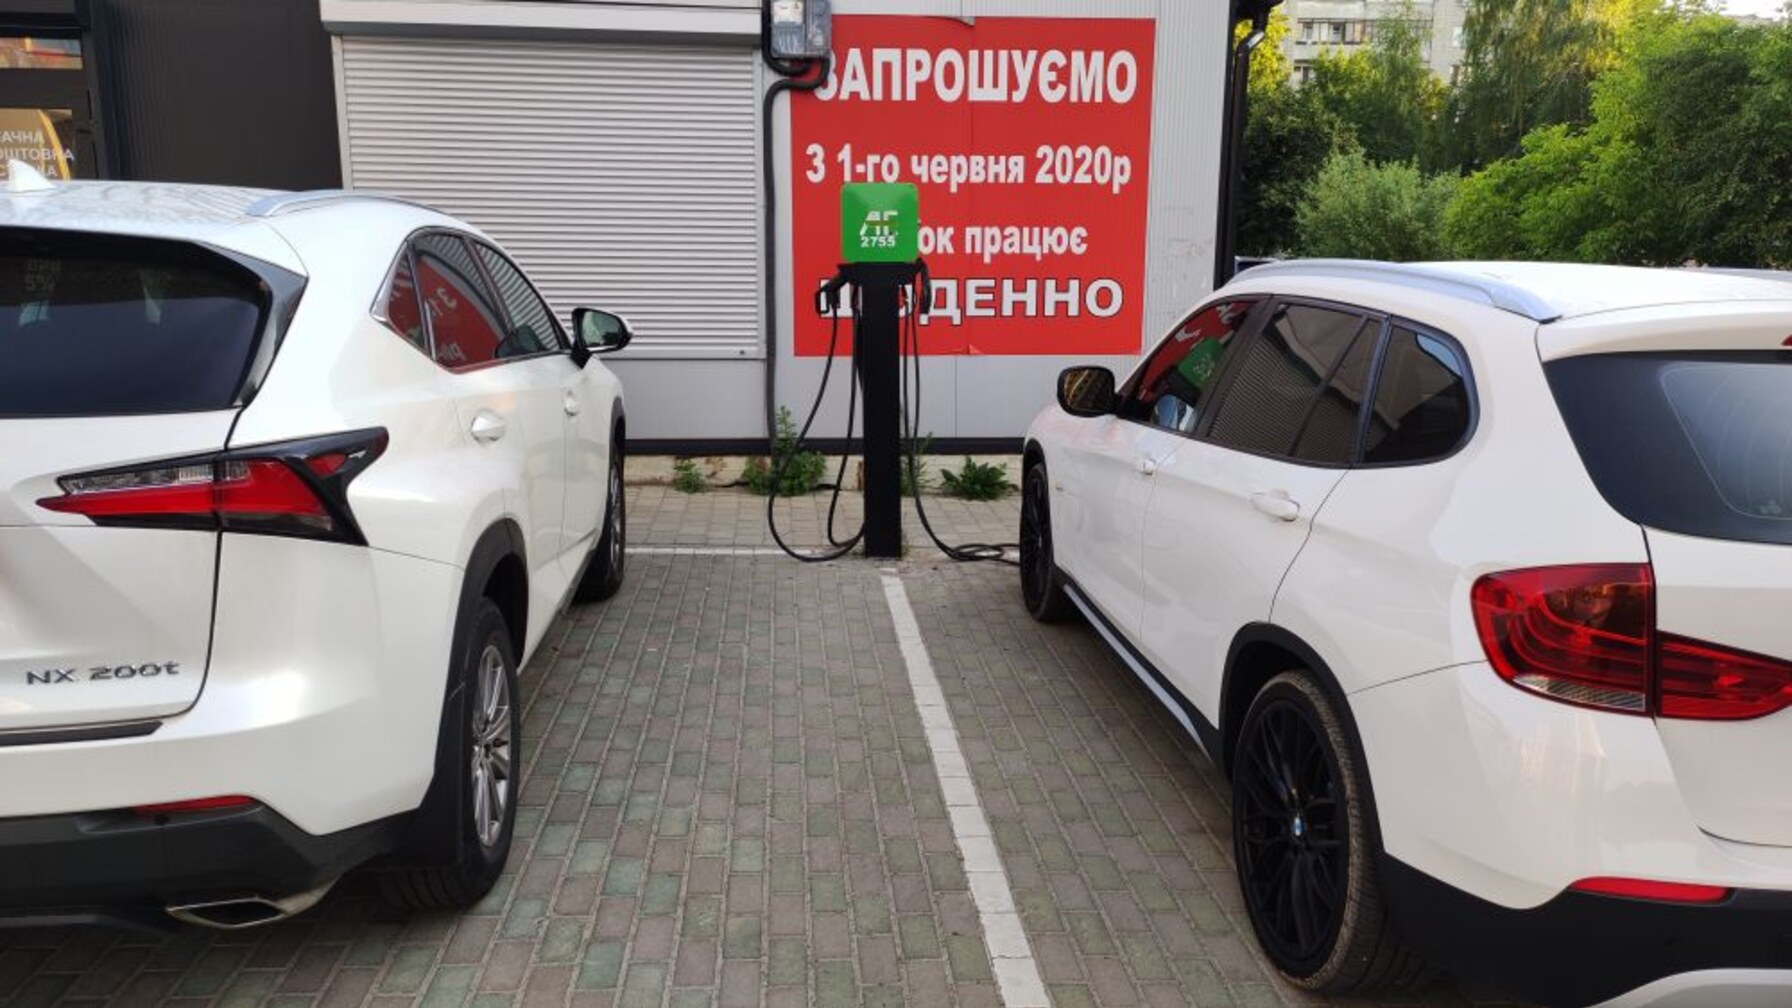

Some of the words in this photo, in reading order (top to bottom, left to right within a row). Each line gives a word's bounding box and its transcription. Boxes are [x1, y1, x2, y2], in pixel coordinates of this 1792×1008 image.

[813, 47, 1137, 104] ЗАПРОШУЄМО
[0, 130, 45, 144] АЧНА
[837, 143, 900, 183] 1-го
[910, 154, 1025, 193] червня
[1035, 144, 1132, 194] 2020р
[860, 235, 896, 248] 2755
[965, 225, 1088, 264] працює
[26, 668, 76, 685] NX
[89, 660, 180, 681] 200t
